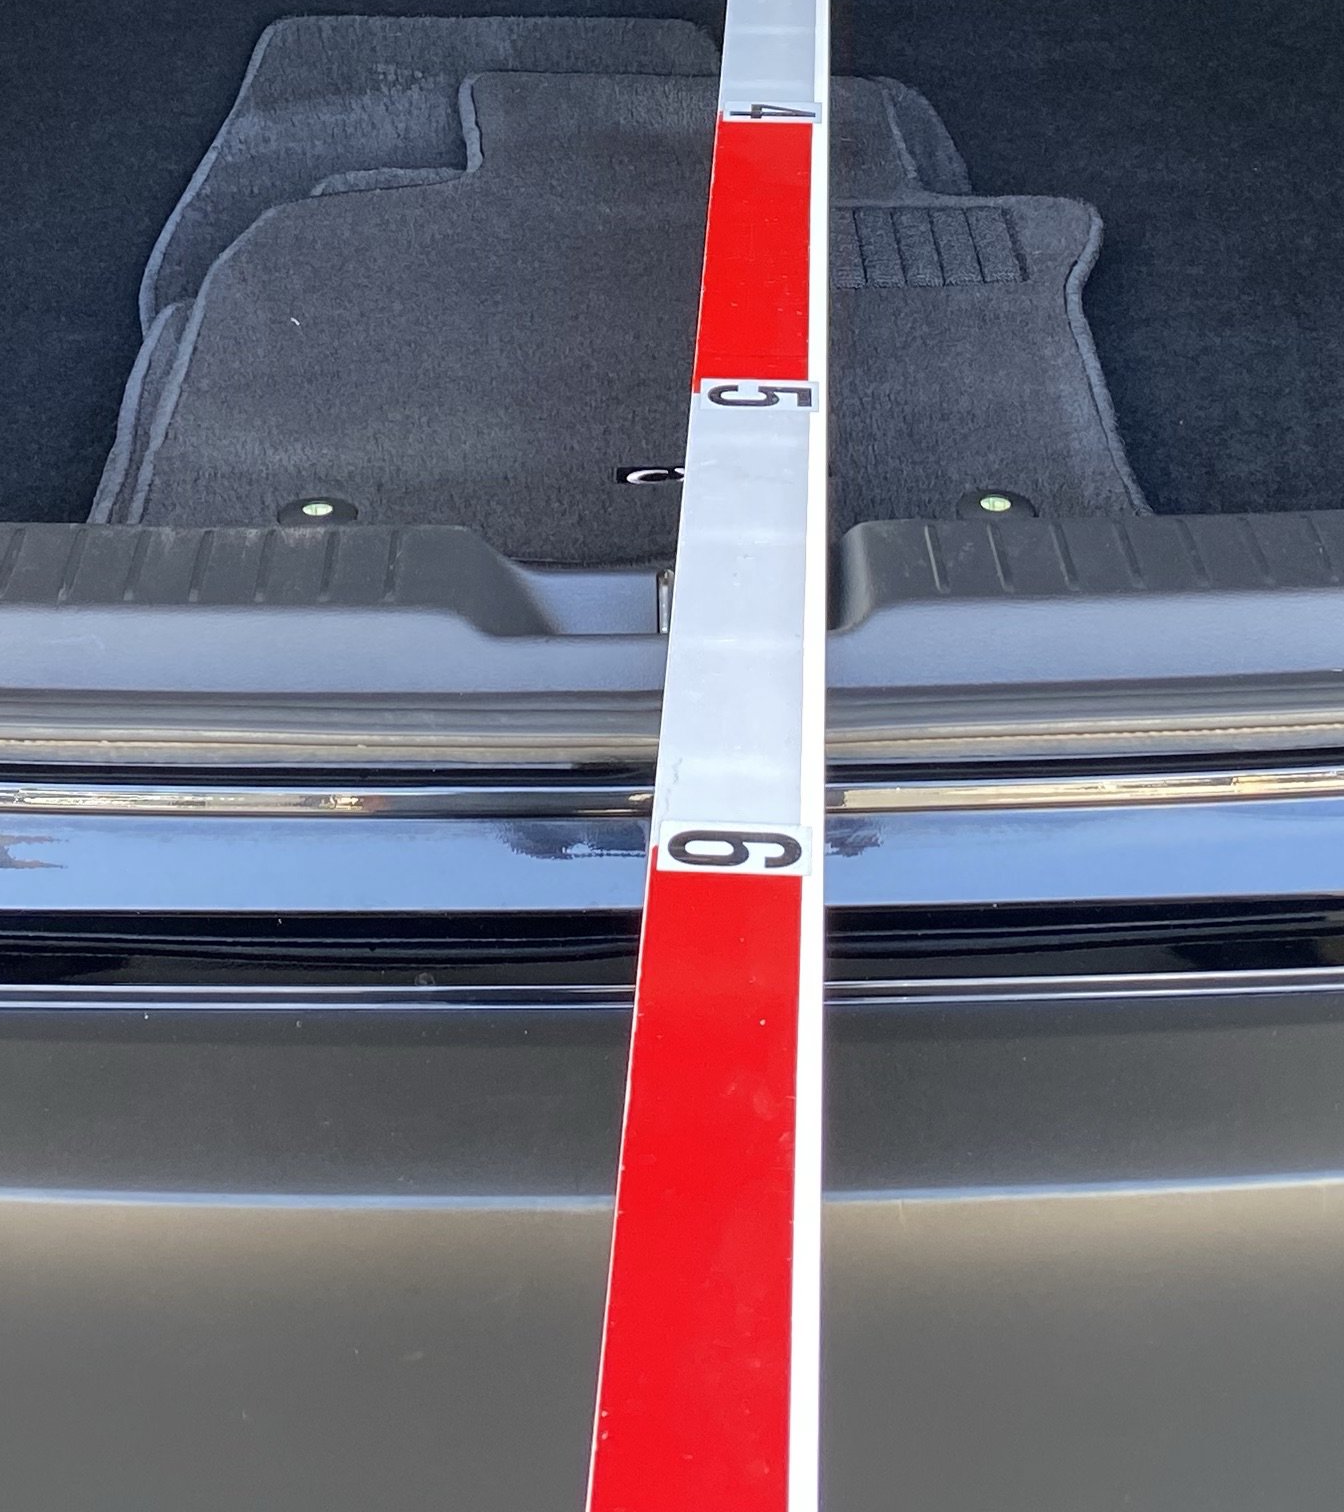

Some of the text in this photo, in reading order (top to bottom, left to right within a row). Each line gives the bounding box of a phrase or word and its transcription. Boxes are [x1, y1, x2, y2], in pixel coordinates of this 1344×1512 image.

[729, 103, 816, 119] 4
[707, 383, 813, 408] 5
[667, 828, 803, 869] 6
